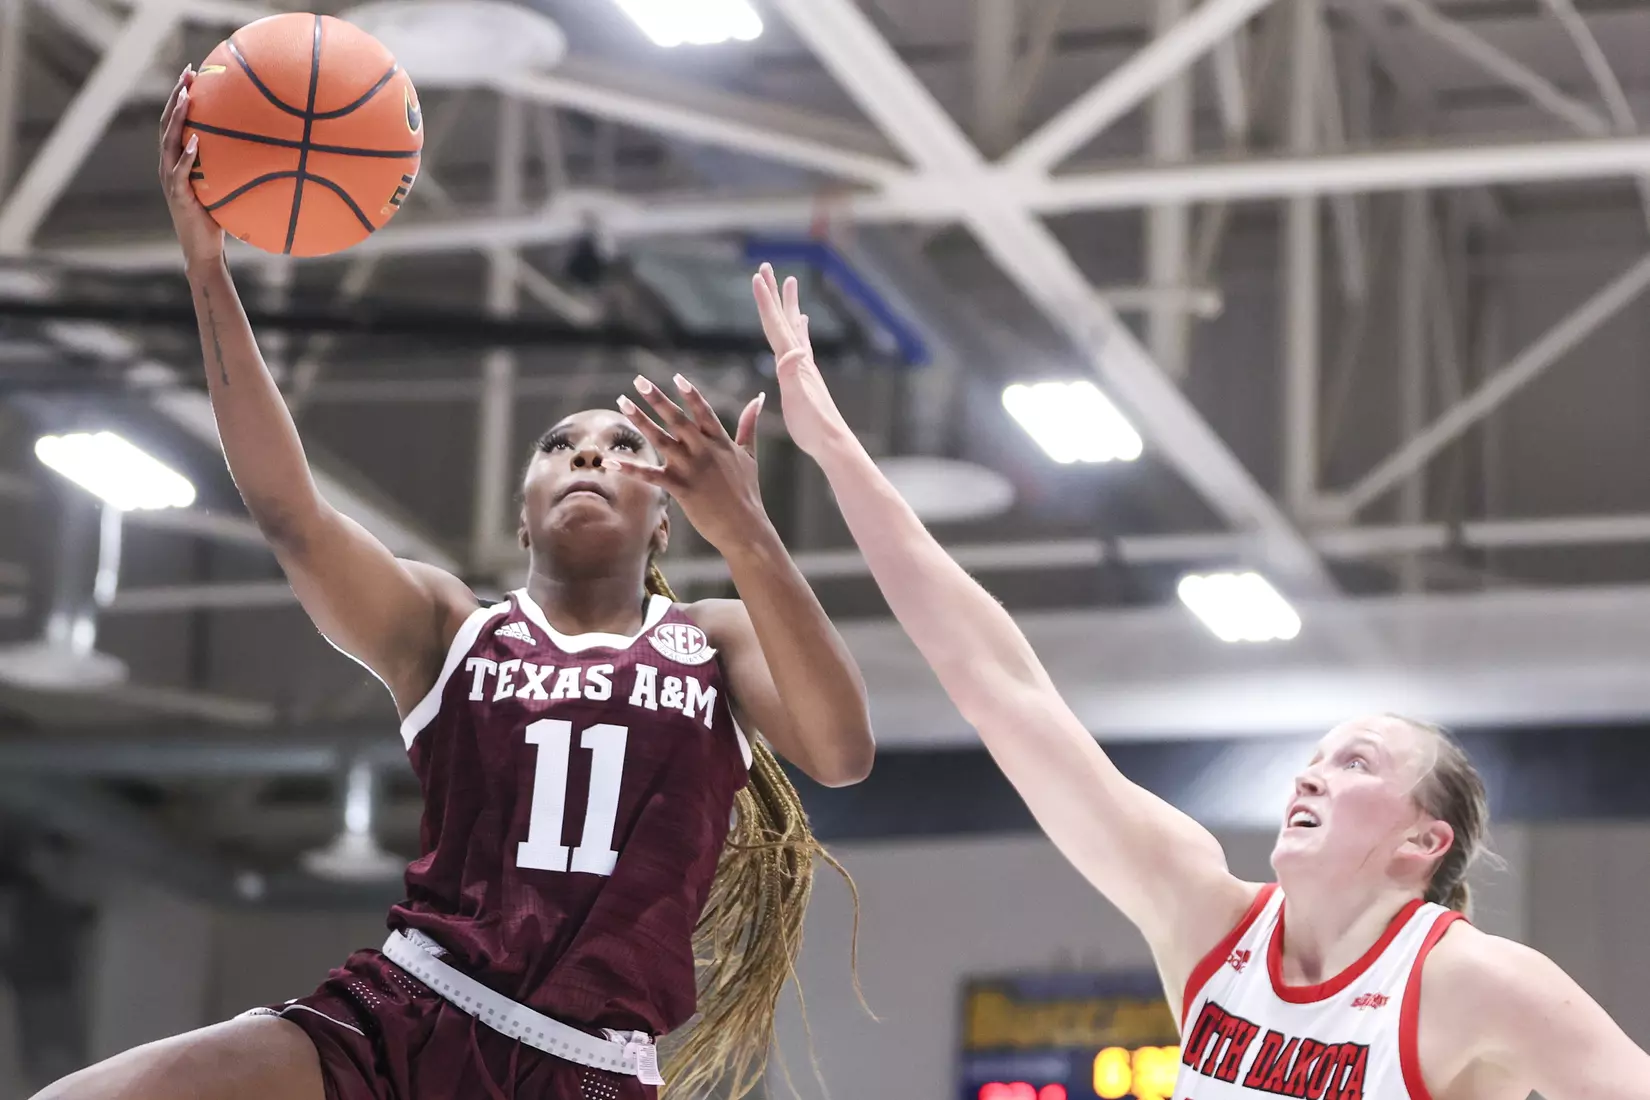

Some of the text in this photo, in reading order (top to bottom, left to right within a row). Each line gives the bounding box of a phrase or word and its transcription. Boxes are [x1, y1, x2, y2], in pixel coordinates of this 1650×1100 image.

[658, 625, 703, 655] SEC
[465, 657, 718, 729] TEXAS A&M
[516, 718, 629, 876] 11
[1242, 1029, 1370, 1100] DAKOTA
